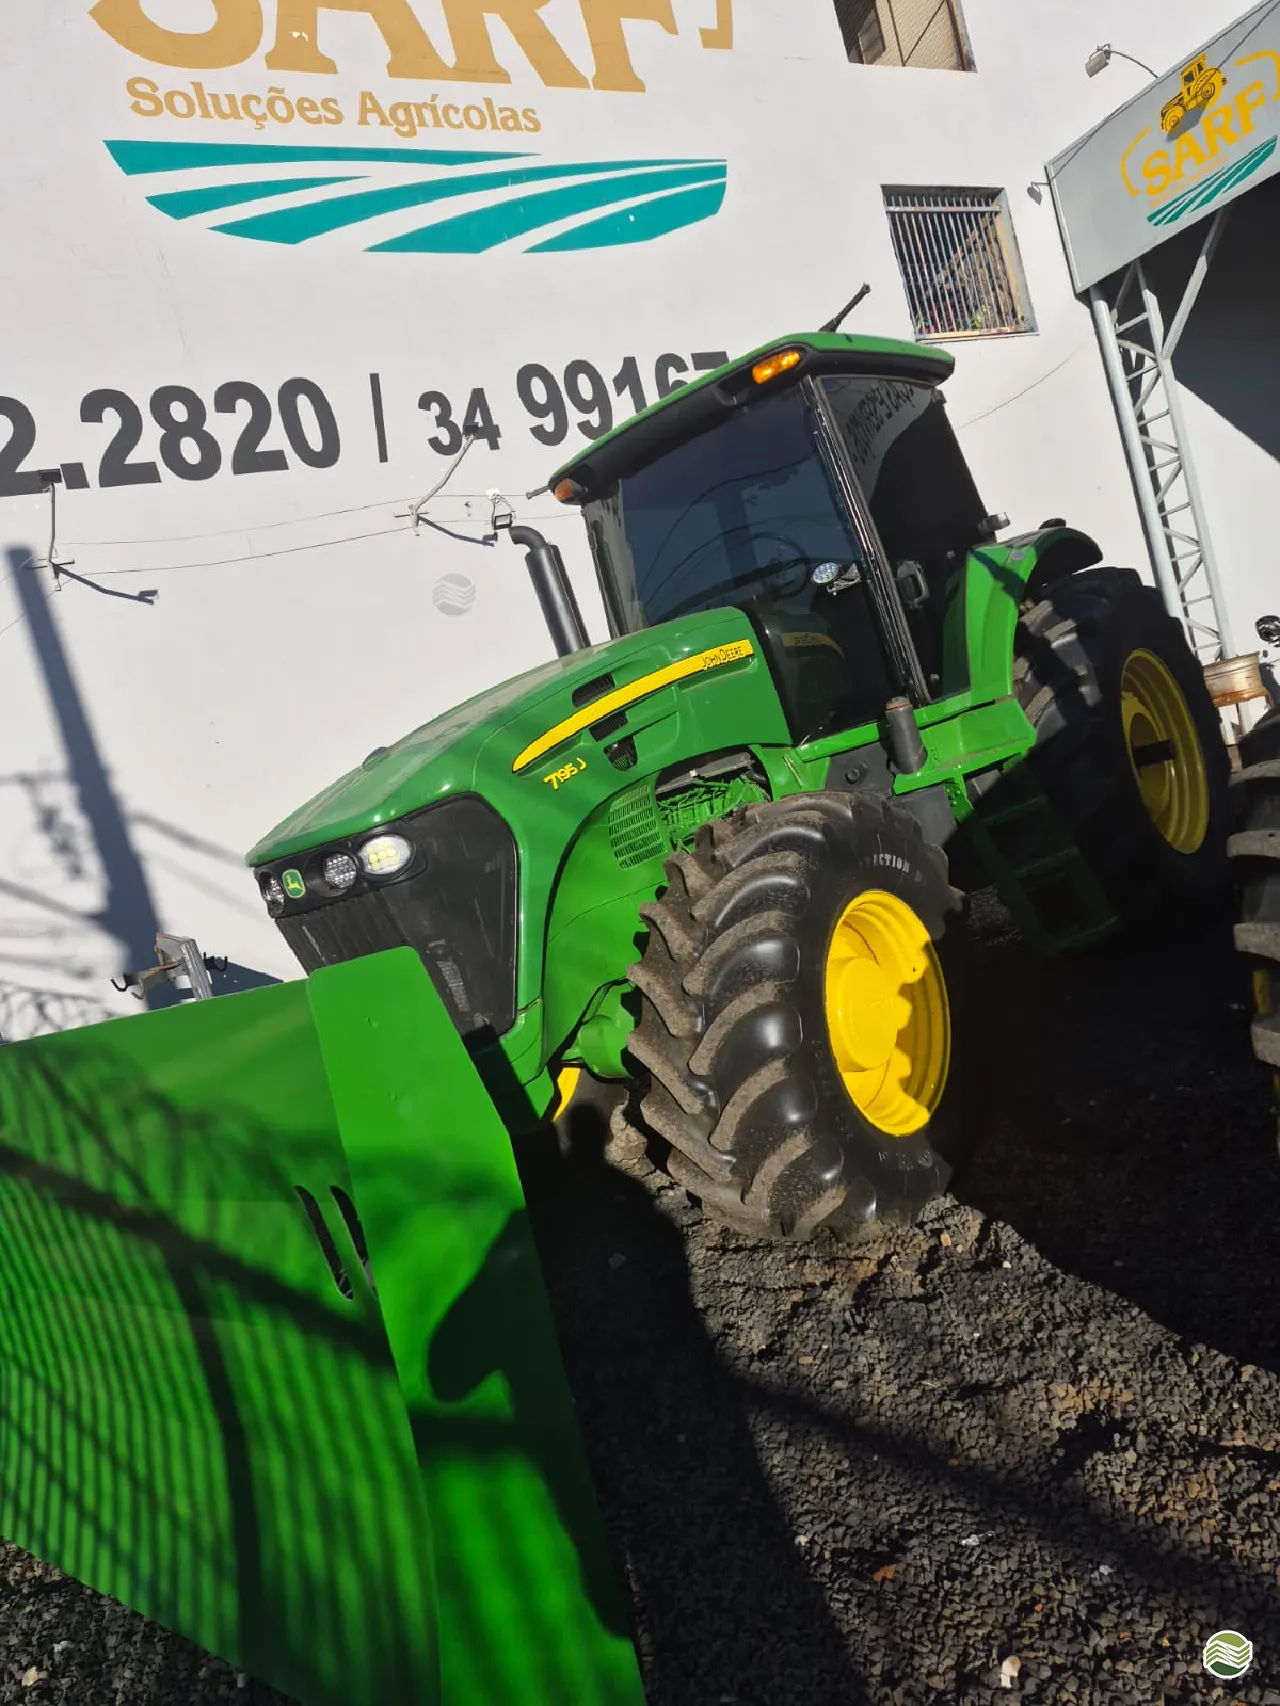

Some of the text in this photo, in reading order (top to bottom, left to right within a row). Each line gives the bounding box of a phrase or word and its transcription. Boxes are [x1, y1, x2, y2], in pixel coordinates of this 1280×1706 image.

[127, 77, 542, 138] Soluções Agrícolas
[1142, 79, 1266, 197] SARF
[418, 387, 501, 456] 34
[516, 351, 729, 447] 9916
